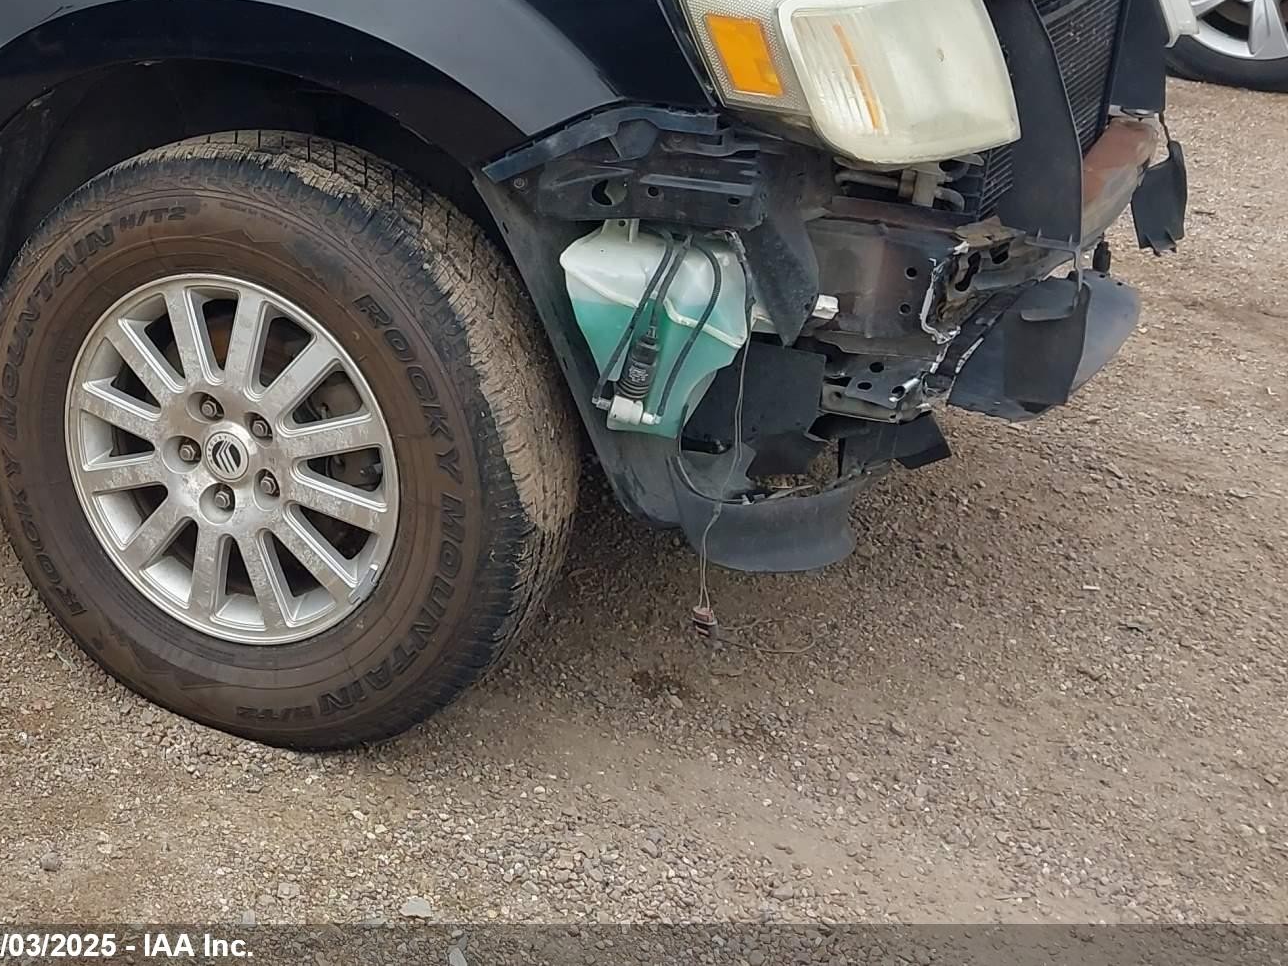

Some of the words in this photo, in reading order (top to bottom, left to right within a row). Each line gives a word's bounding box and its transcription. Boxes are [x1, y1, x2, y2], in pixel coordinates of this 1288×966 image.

[0, 223, 115, 441] MOUNTAIN
[352, 294, 463, 484] ROCKY
[318, 491, 466, 716] MOUNTAIN
